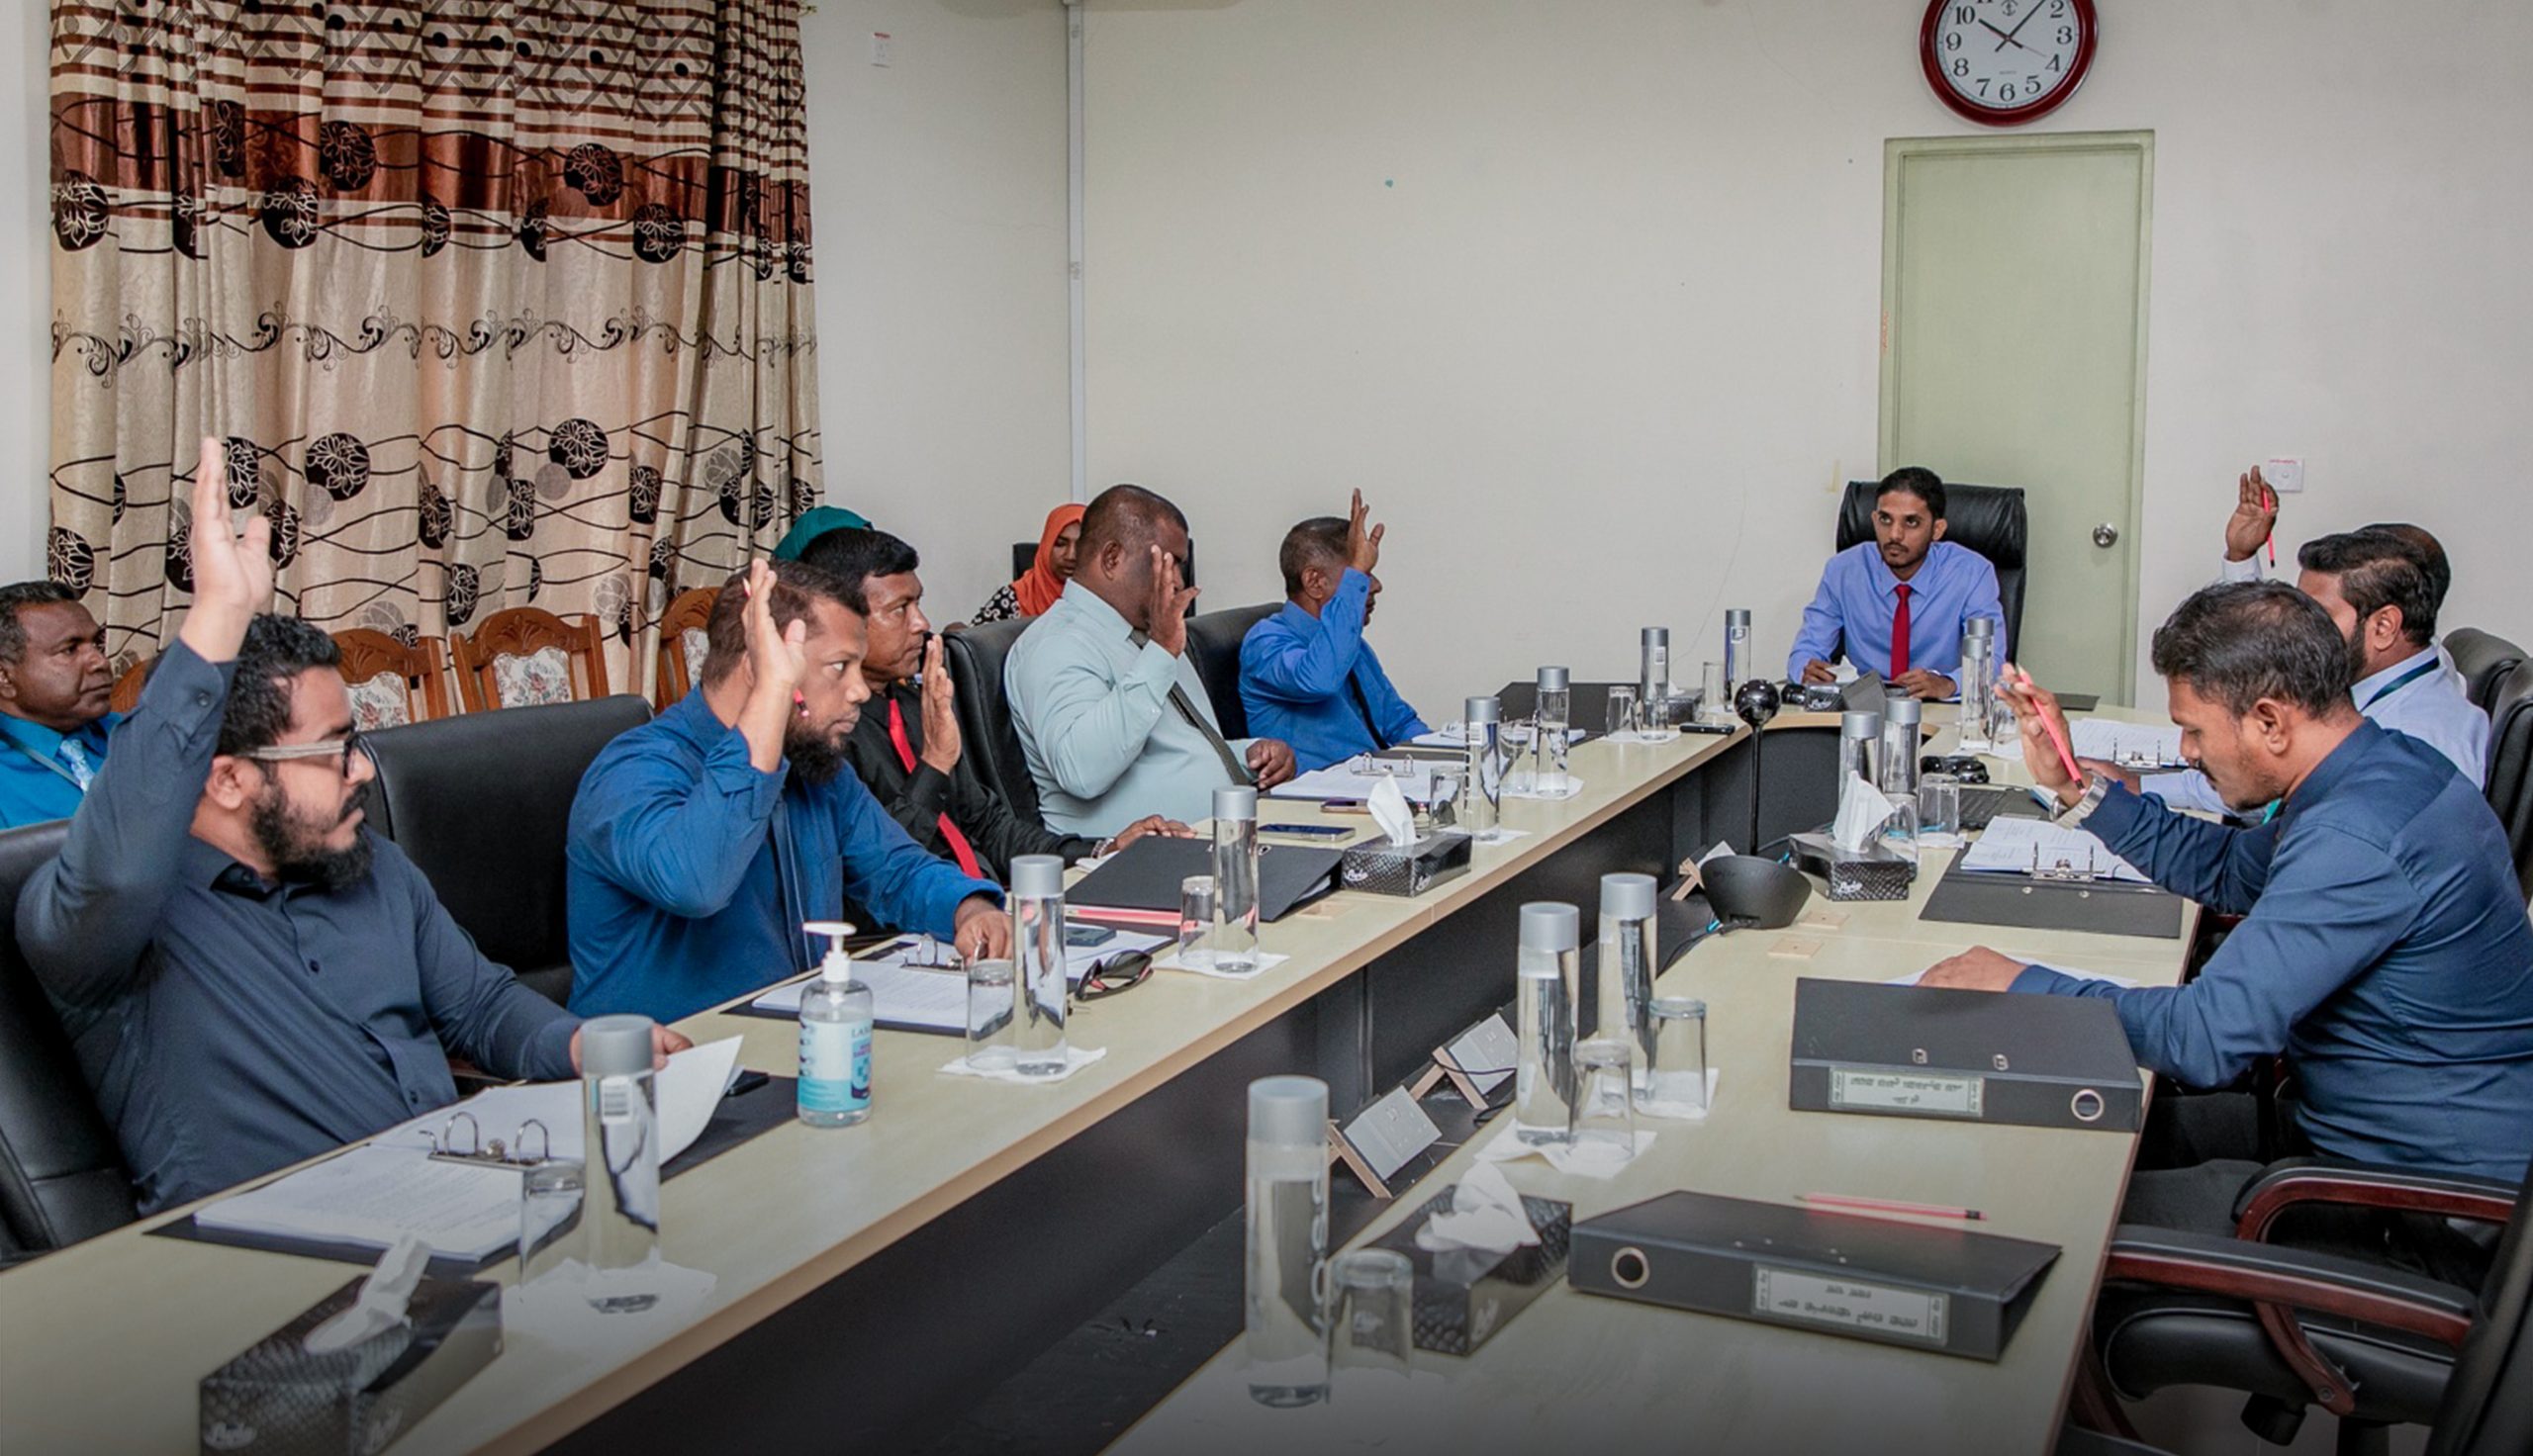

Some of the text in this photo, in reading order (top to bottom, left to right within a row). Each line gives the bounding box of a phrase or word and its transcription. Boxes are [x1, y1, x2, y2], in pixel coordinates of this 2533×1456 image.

[1955, 5, 1976, 25] 10
[2050, 0, 2064, 19] 2
[1945, 32, 1962, 51] 9
[2056, 26, 2073, 46] 3
[1953, 57, 1970, 77] 8
[2045, 53, 2060, 72] 4
[1976, 78, 1991, 97] 7
[1999, 82, 2017, 102] 6
[2024, 74, 2041, 95] 5
